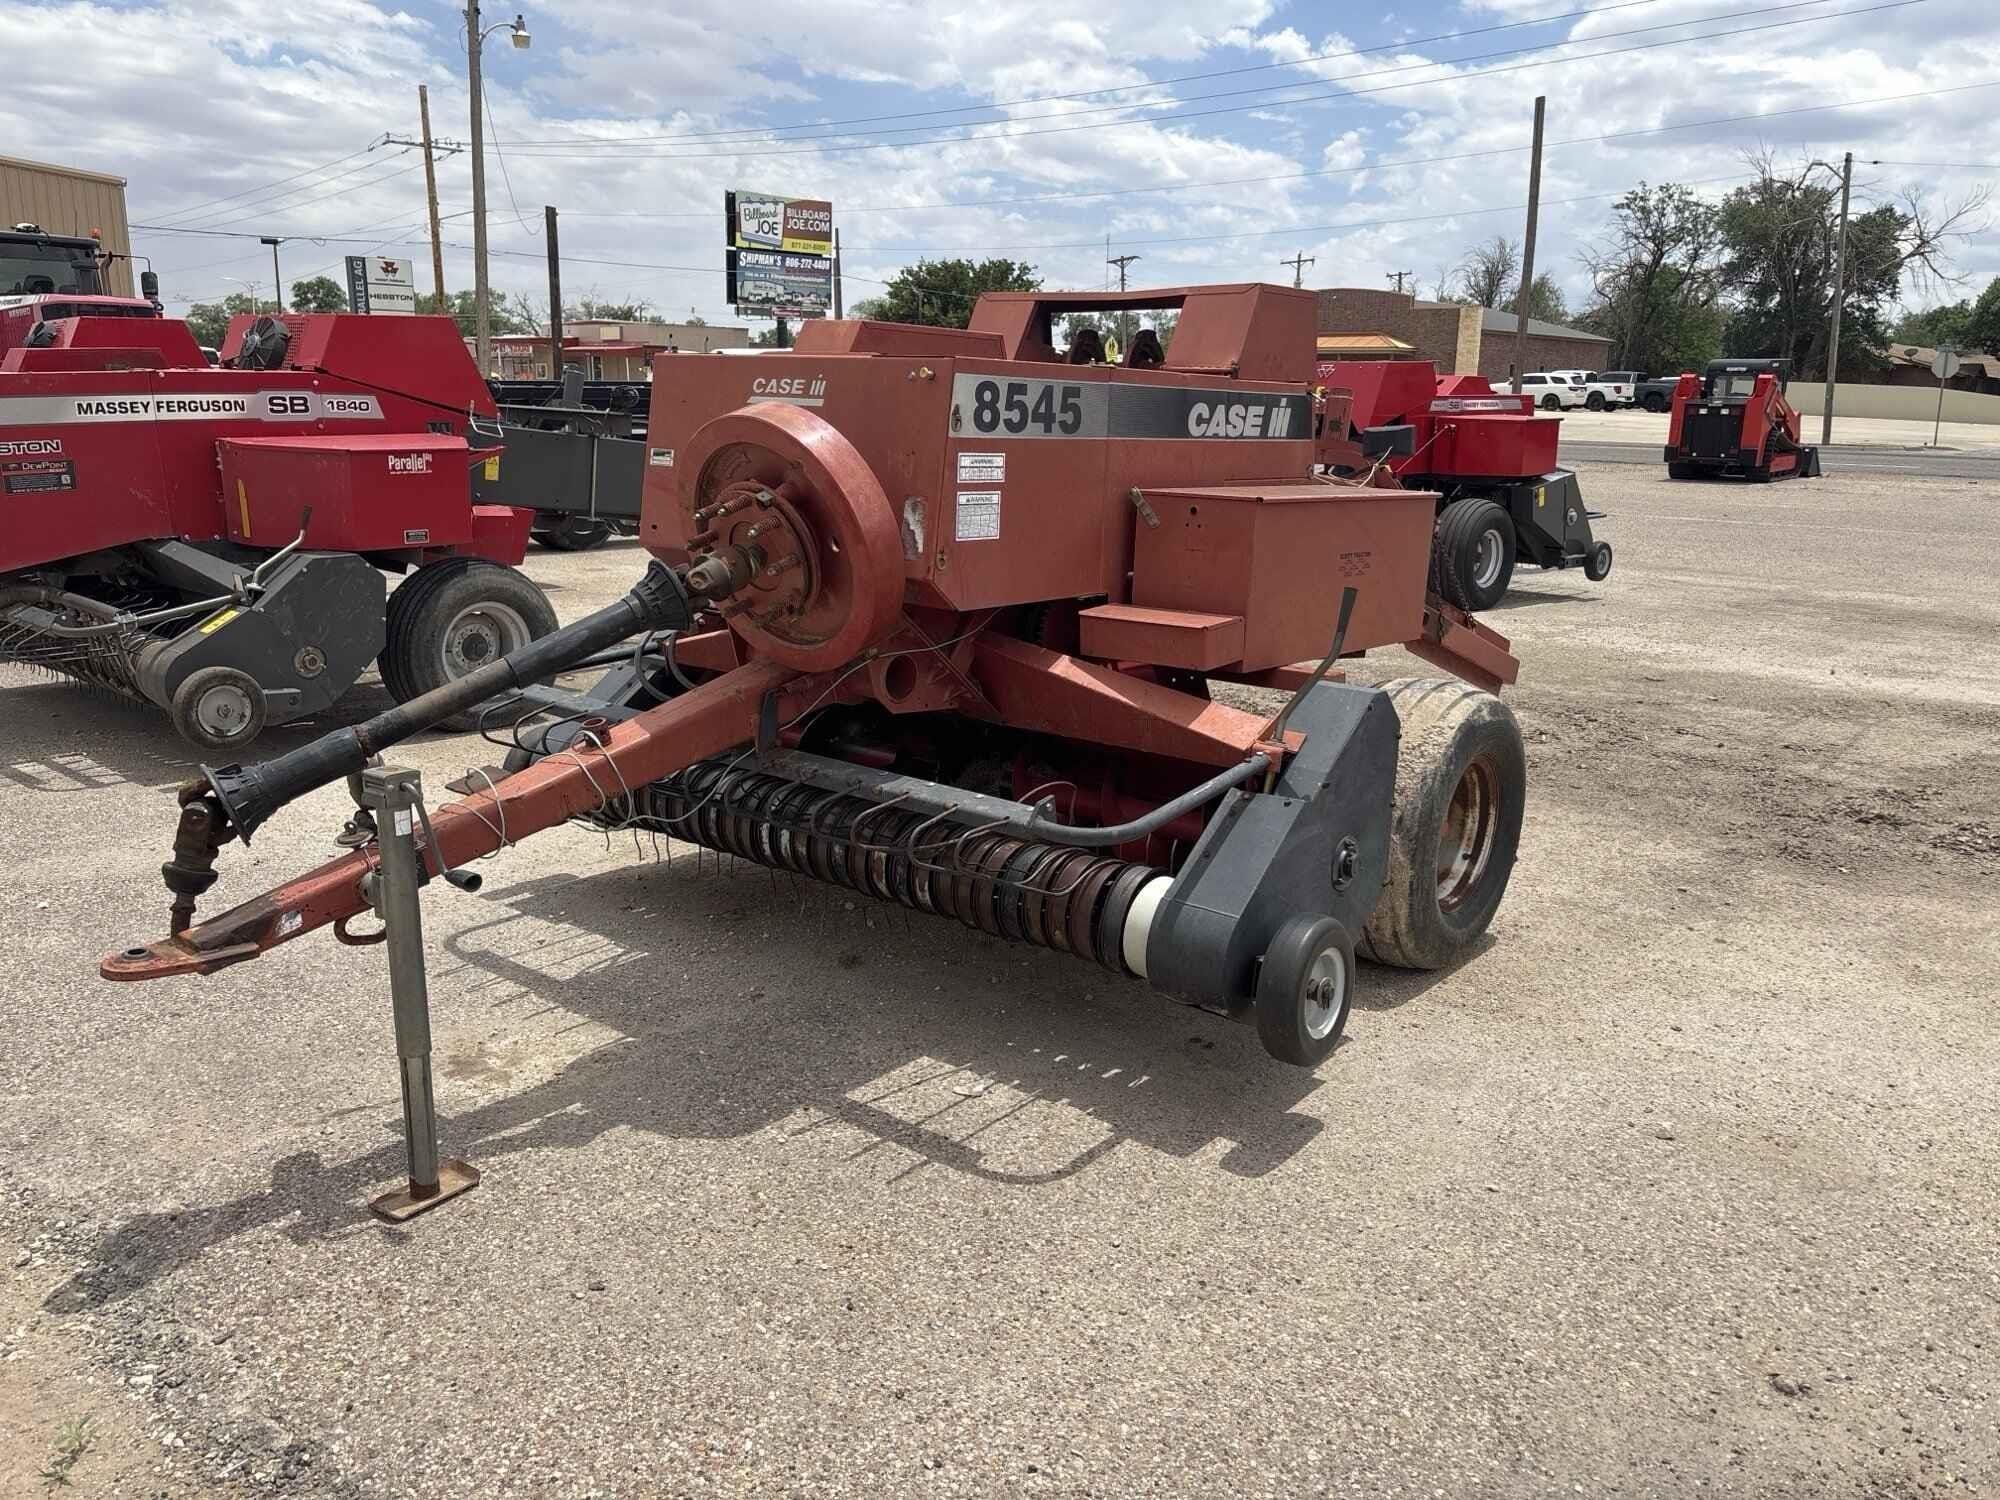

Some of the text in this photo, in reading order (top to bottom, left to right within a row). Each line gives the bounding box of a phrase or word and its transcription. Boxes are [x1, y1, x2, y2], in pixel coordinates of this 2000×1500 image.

[786, 208, 830, 220] BILLBOARD
[755, 220, 779, 236] JOE
[786, 220, 830, 233] JOE.COM
[740, 252, 782, 266] SHIPMAN'S
[752, 378, 806, 395] CASE
[76, 395, 370, 415] MASSEY FERGUSON SB 1840
[973, 380, 1082, 434] 8545
[1187, 402, 1265, 438] CASE
[388, 453, 426, 471] Parallel
